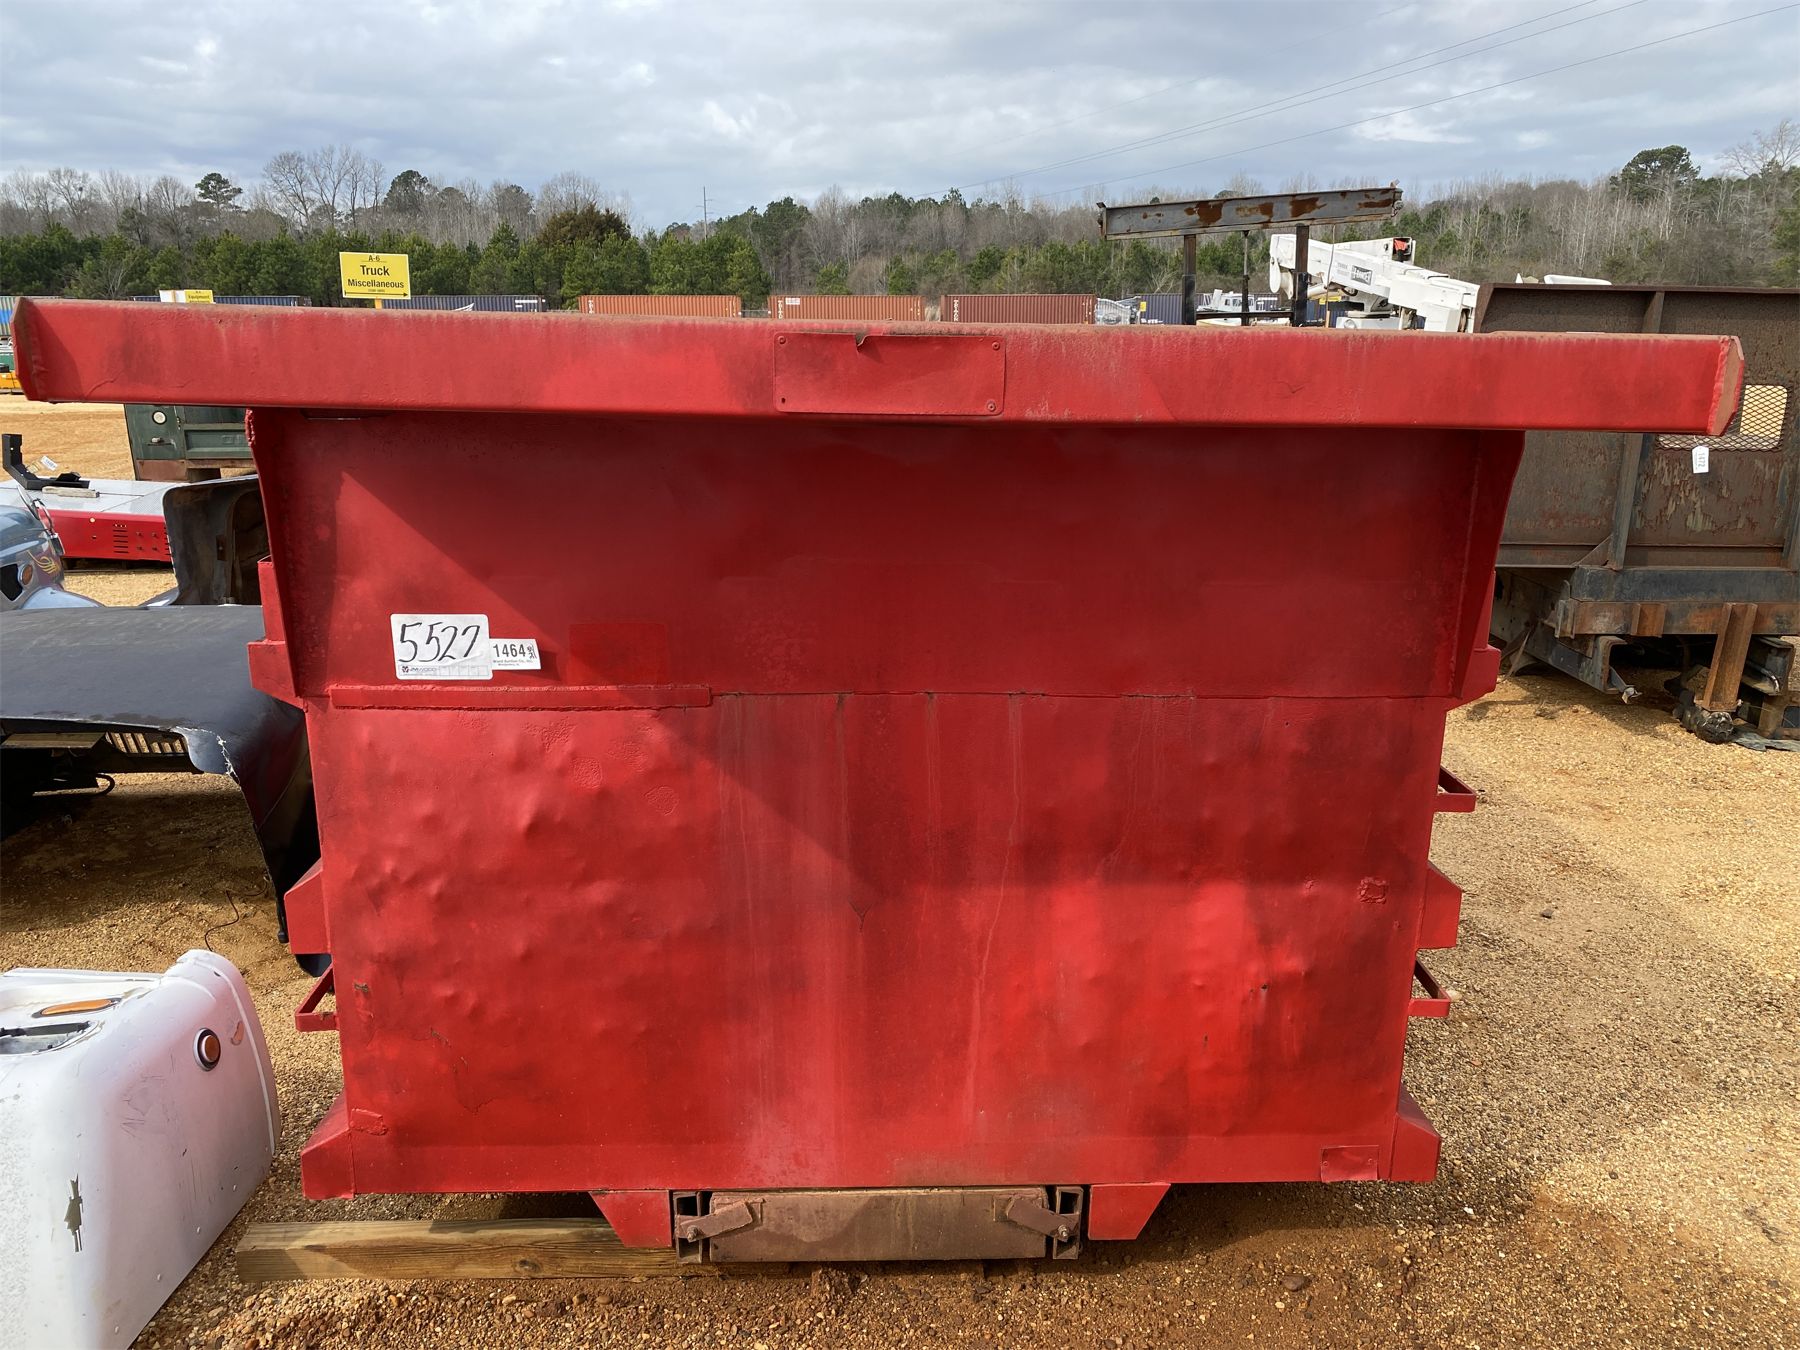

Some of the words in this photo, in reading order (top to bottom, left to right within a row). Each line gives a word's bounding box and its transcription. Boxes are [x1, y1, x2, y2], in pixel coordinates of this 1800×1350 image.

[360, 264, 390, 276] Truck
[347, 278, 405, 289] Miscellaneous
[397, 622, 481, 663] 5527
[492, 643, 526, 658] 1464
